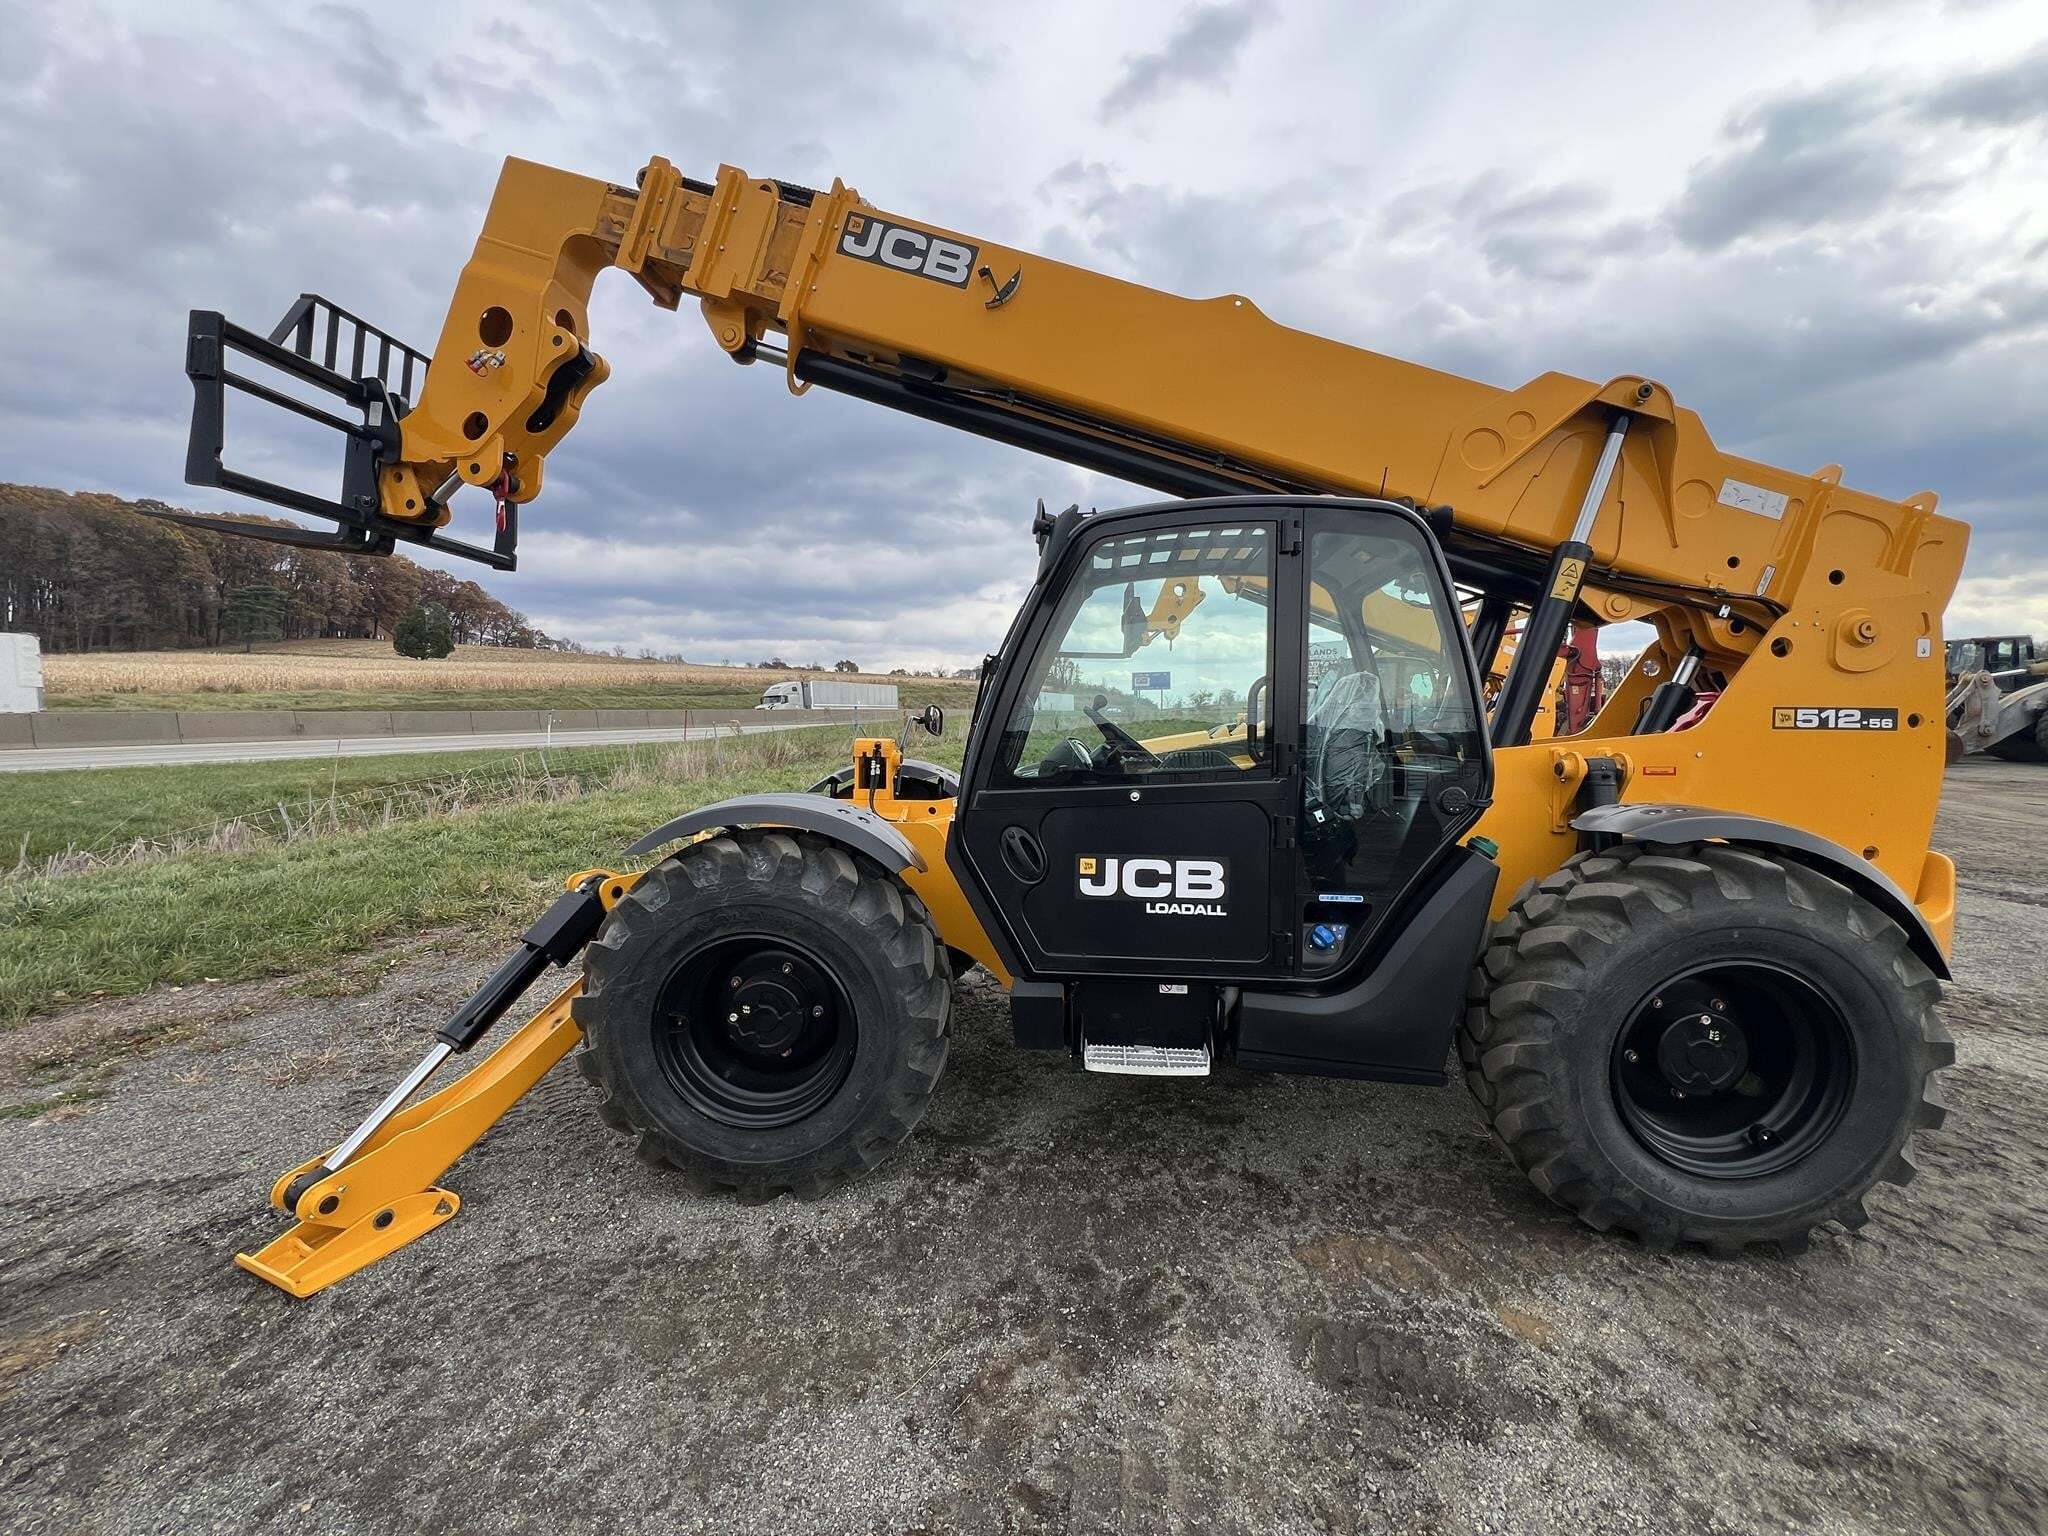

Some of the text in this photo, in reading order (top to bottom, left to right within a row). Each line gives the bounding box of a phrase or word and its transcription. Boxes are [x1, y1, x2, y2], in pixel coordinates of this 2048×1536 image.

[842, 222, 972, 283] JCB
[1795, 709, 1893, 729] 512-56
[1079, 858, 1225, 900] JCB
[1146, 902, 1228, 916] LOADALL
